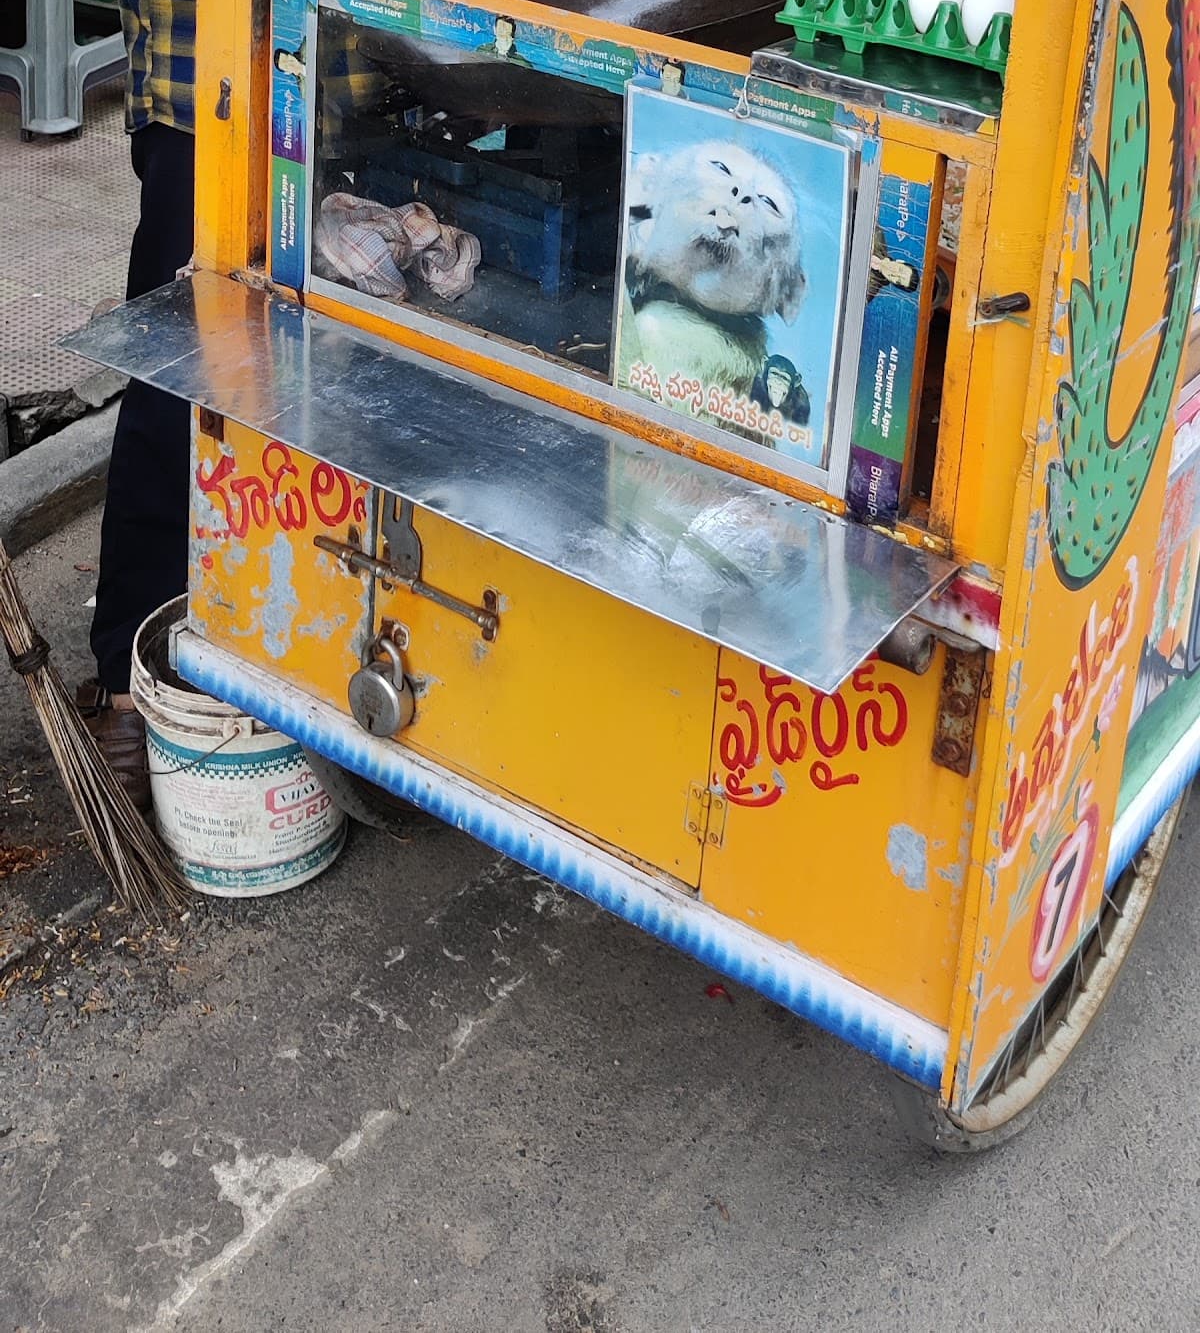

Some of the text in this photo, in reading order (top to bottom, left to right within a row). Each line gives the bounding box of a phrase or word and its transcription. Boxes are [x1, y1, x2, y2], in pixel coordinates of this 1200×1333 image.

[349, 0, 384, 15] Accepted
[605, 63, 626, 76] Here
[790, 104, 817, 119] Apps
[288, 204, 296, 247] Accepted
[871, 349, 887, 426] Accepted Here
[881, 346, 898, 439] All Payment Apps
[262, 756, 288, 768] UNION
[268, 794, 333, 831] CURD
